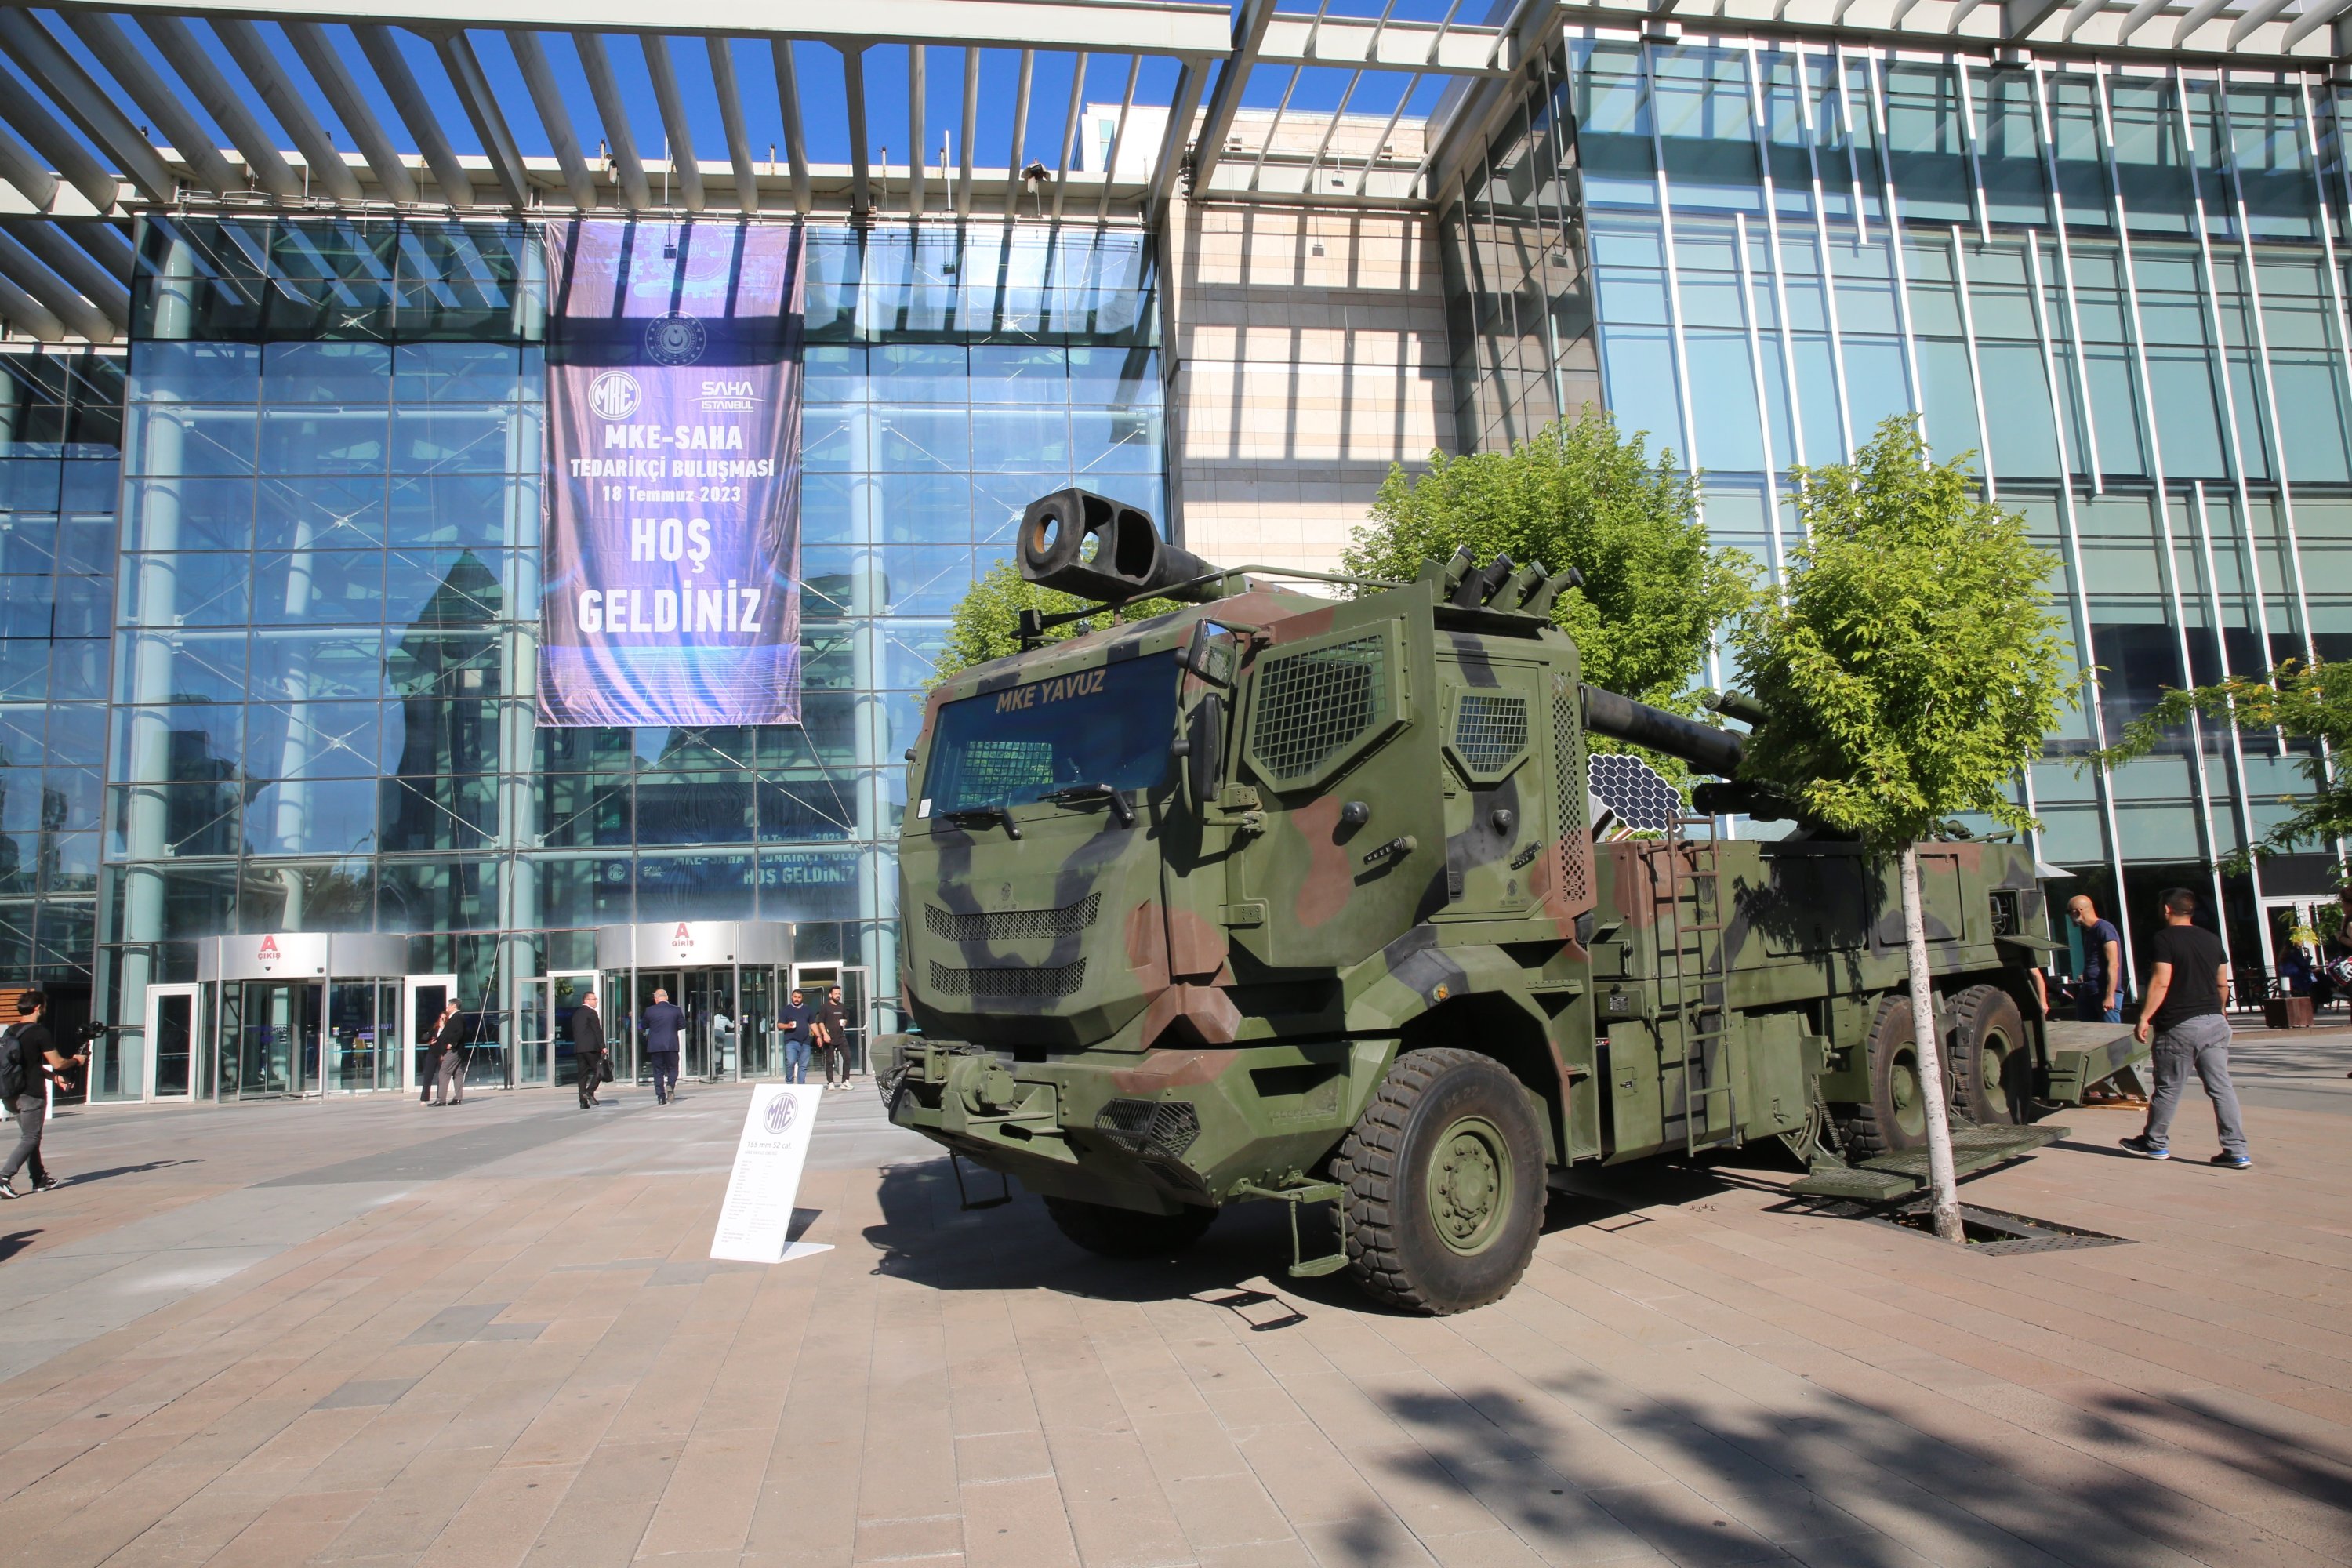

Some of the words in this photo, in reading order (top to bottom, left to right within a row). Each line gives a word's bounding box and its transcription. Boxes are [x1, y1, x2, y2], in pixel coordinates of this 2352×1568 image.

[594, 375, 636, 416] MKE
[701, 381, 754, 396] SAHA
[604, 424, 743, 450] MKE-SAHA
[570, 456, 666, 482] TEDARİKÇİ
[672, 459, 775, 483] BULUŞMASI
[602, 486, 622, 502] 18
[627, 486, 694, 502] Temmuz
[699, 486, 741, 502] 2023
[630, 517, 711, 573] HOŞ
[578, 579, 761, 633] GELDİNİZ
[996, 685, 1036, 714] MKE
[1041, 669, 1106, 704] YAVUZ
[743, 867, 777, 887] HOŞ
[782, 865, 856, 884] GELDİNİZ
[674, 922, 690, 938] A
[260, 935, 278, 952] A
[767, 1096, 795, 1131] MKE
